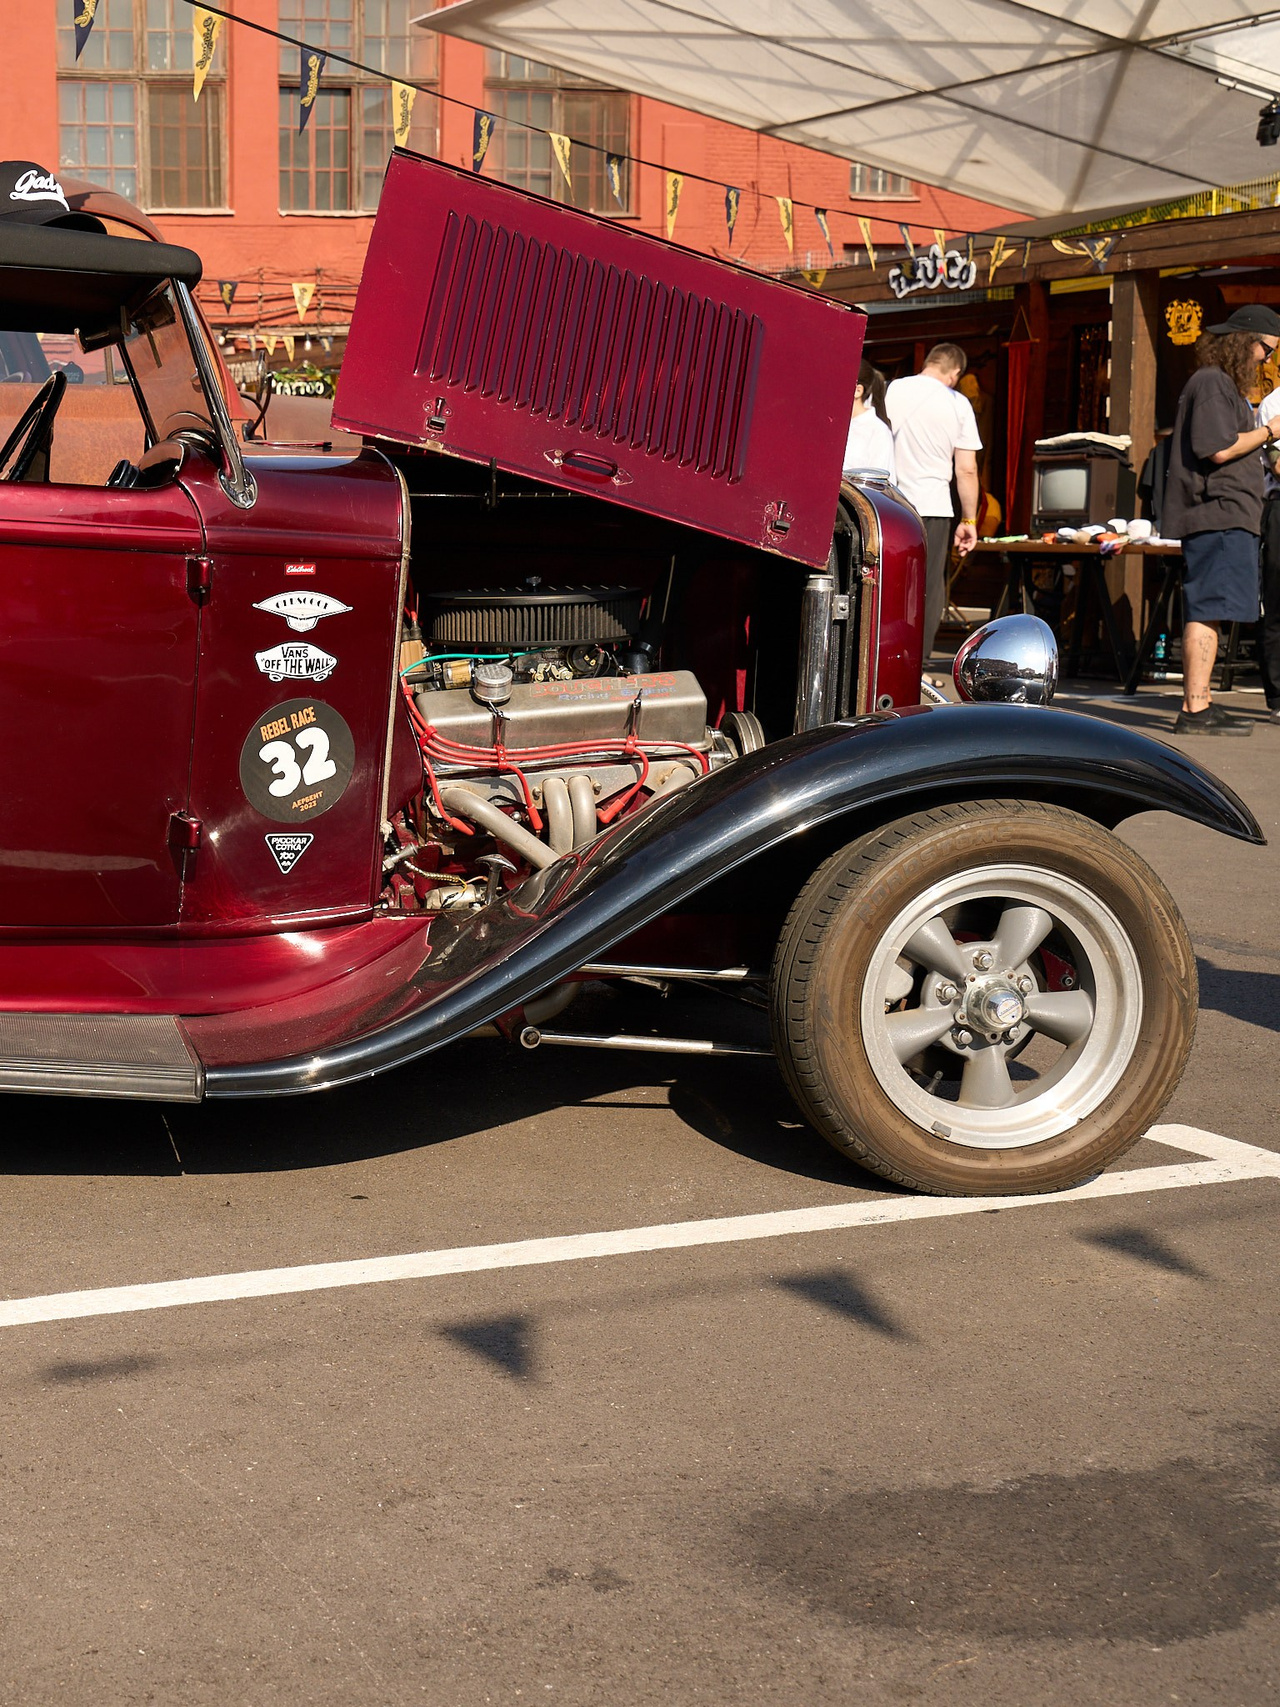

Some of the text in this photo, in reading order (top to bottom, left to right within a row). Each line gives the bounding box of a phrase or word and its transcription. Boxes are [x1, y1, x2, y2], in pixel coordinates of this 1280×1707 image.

[275, 380, 324, 396] TATTOO
[285, 659, 303, 674] THE
[260, 706, 317, 742] REBEL RACE
[259, 727, 337, 797] 32
[271, 837, 308, 845] РУССКАЯ
[856, 825, 1014, 925] ROADSTONE
